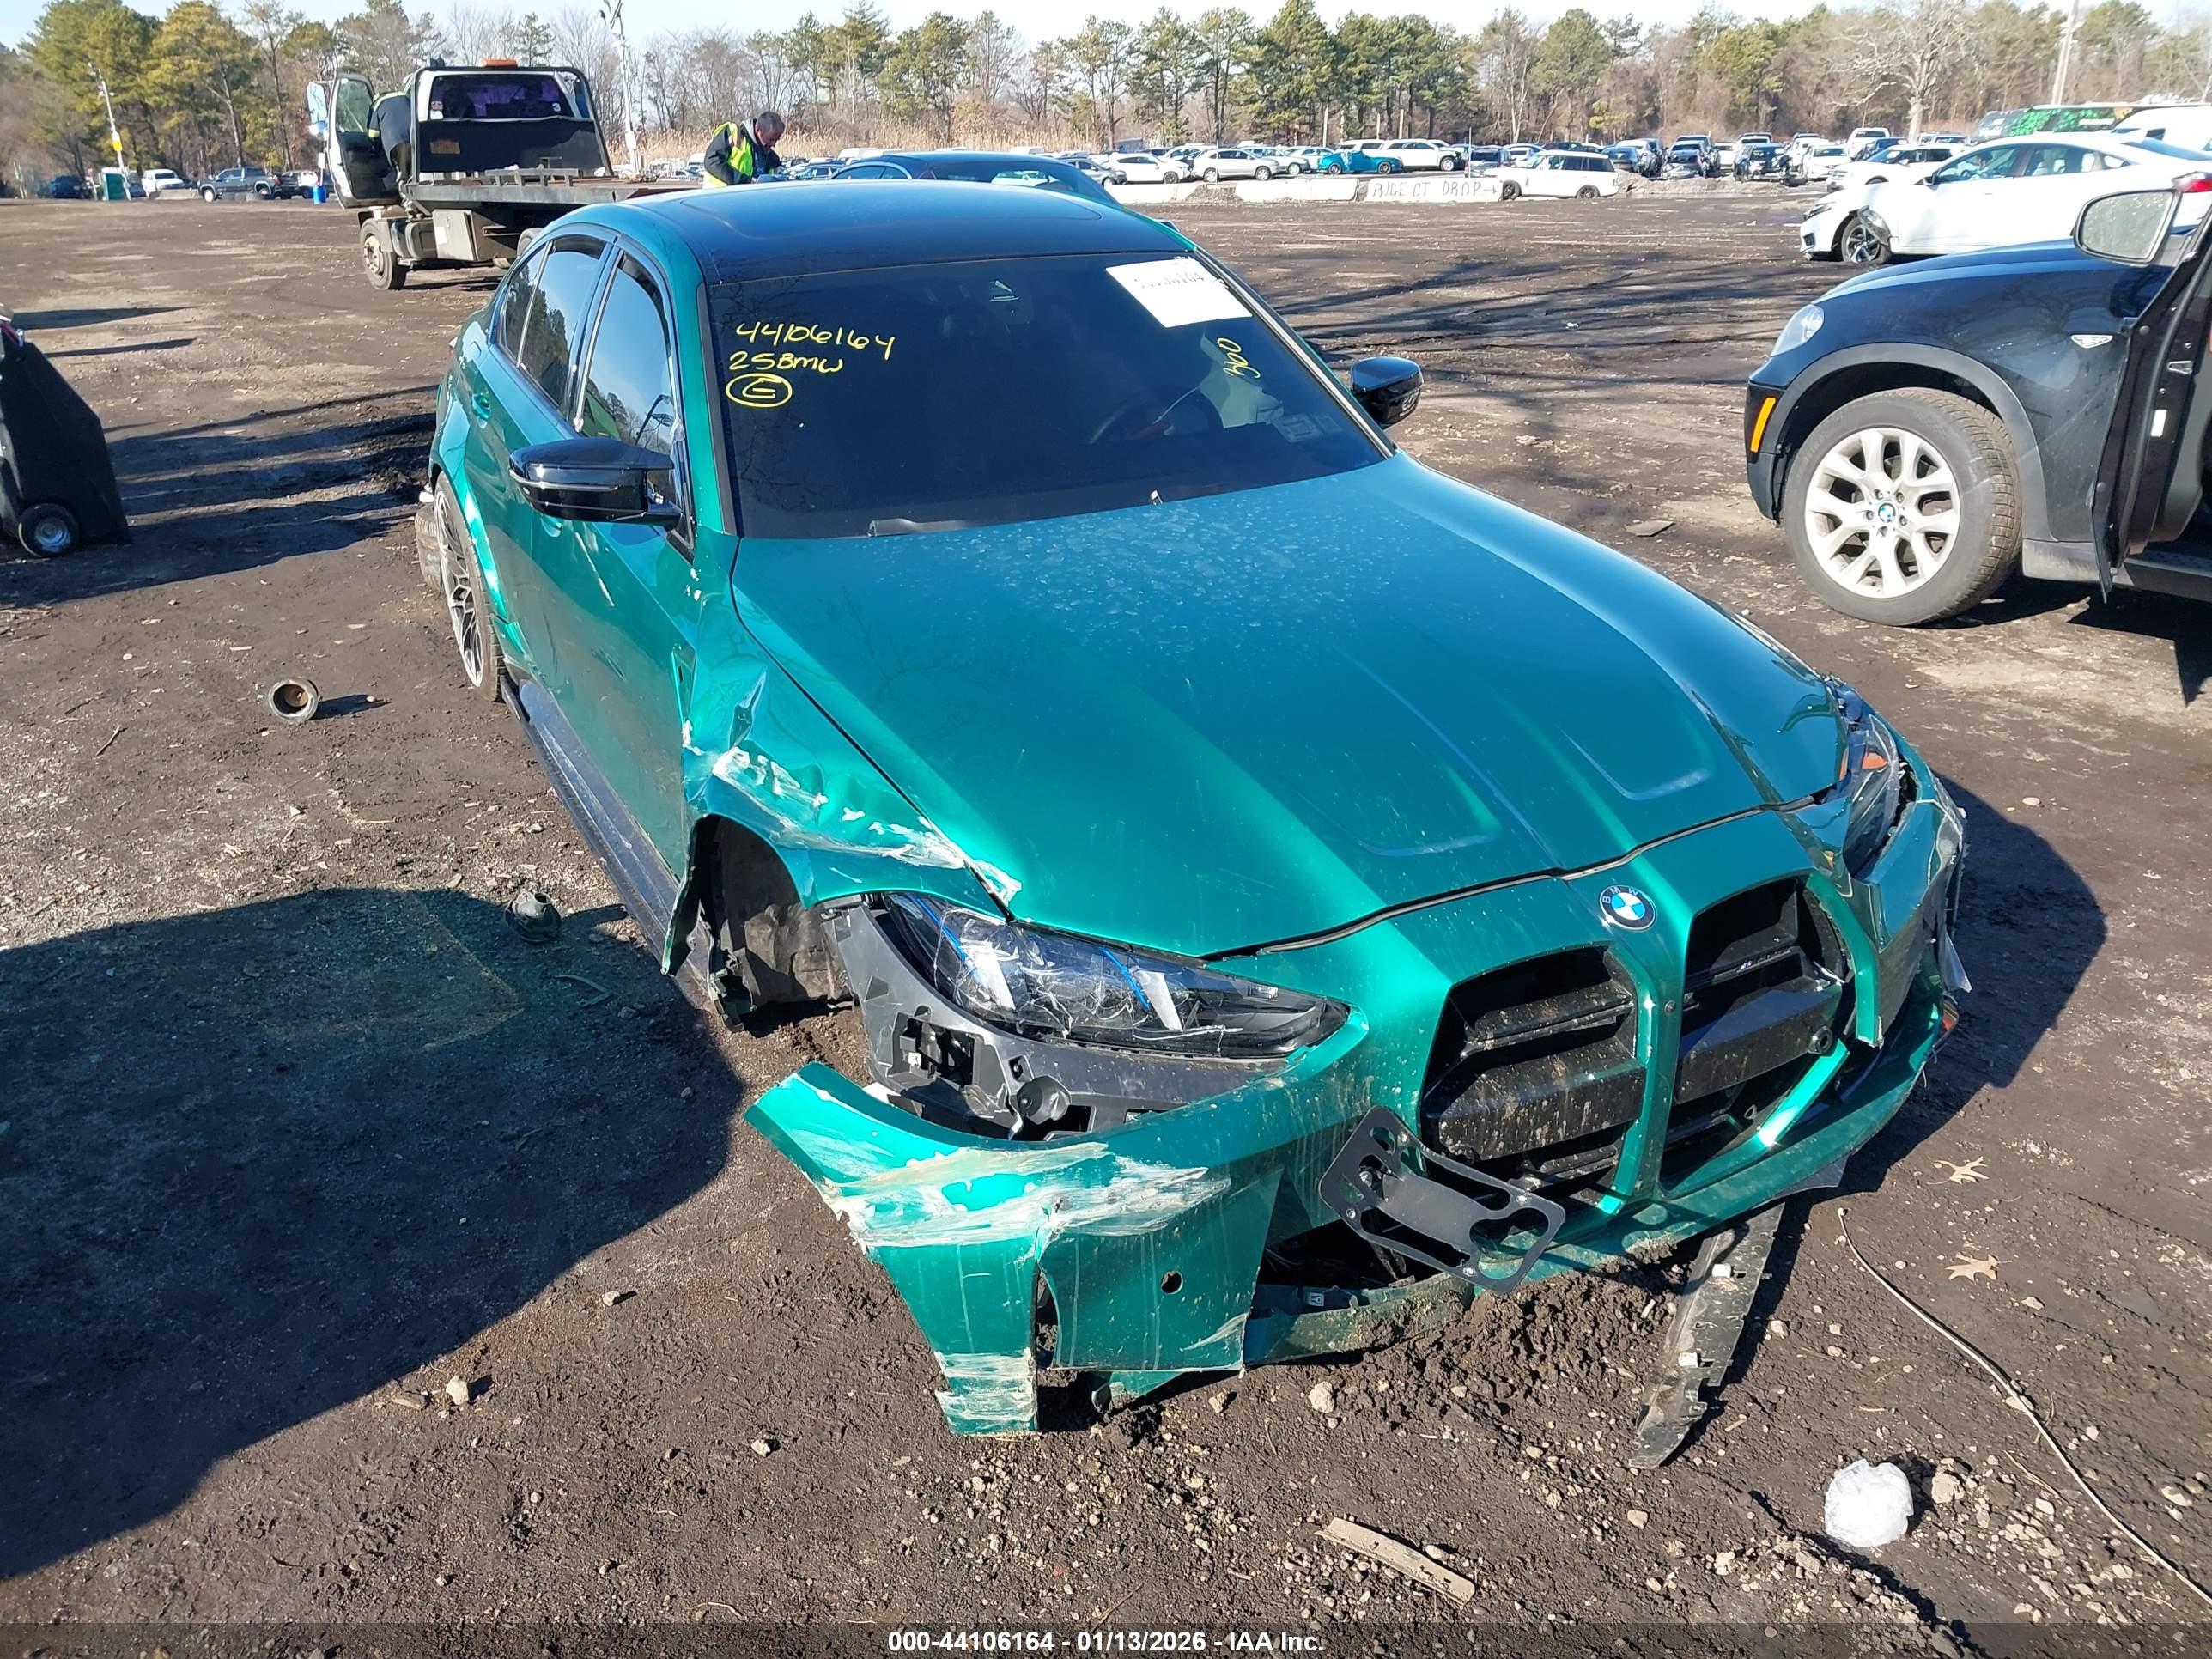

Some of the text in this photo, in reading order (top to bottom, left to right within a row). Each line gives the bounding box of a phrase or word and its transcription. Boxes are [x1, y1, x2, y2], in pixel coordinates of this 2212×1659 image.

[1413, 181, 1431, 198] CT
[1442, 180, 1482, 198] DROP
[735, 321, 896, 361] 44106164
[1602, 886, 1639, 904] BMW
